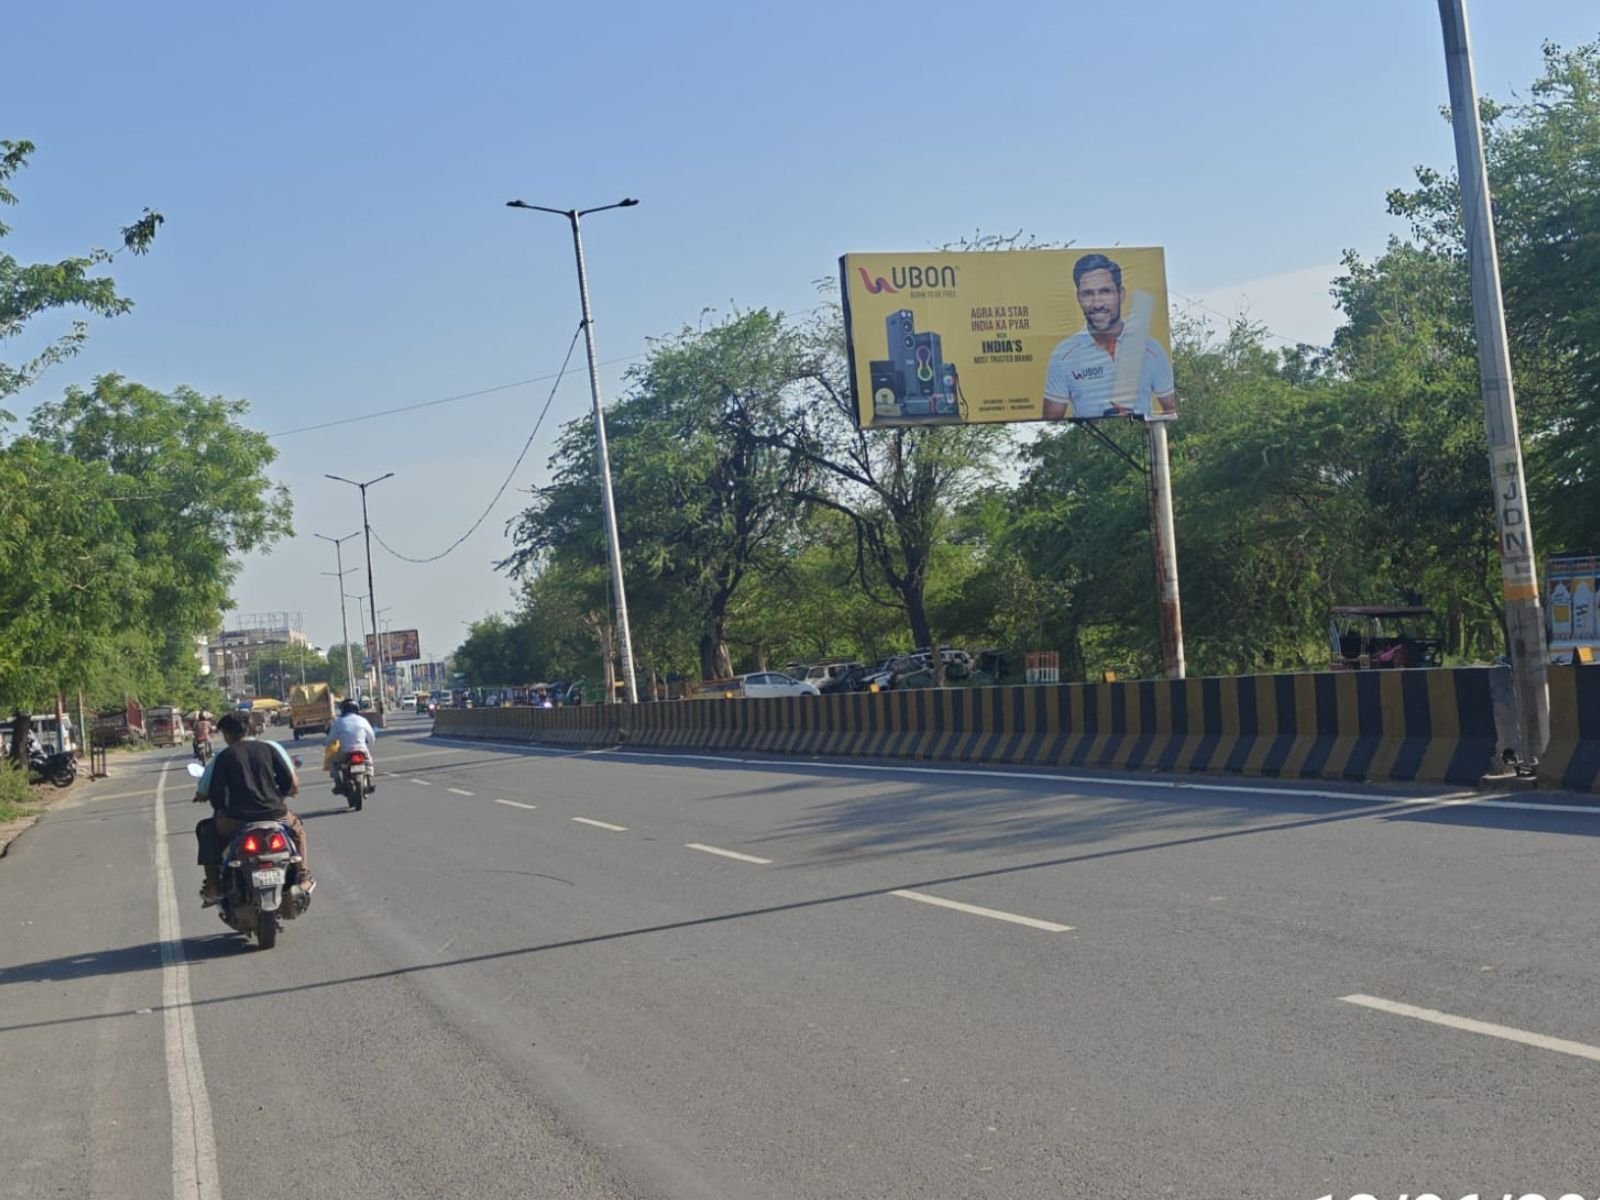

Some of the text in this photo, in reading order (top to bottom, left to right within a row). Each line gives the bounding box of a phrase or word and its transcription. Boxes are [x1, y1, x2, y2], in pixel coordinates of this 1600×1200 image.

[971, 306, 1029, 318] AGRA KA STAR
[971, 318, 1030, 332] INDIA KA PYAR
[982, 339, 1023, 353] INDIA'S
